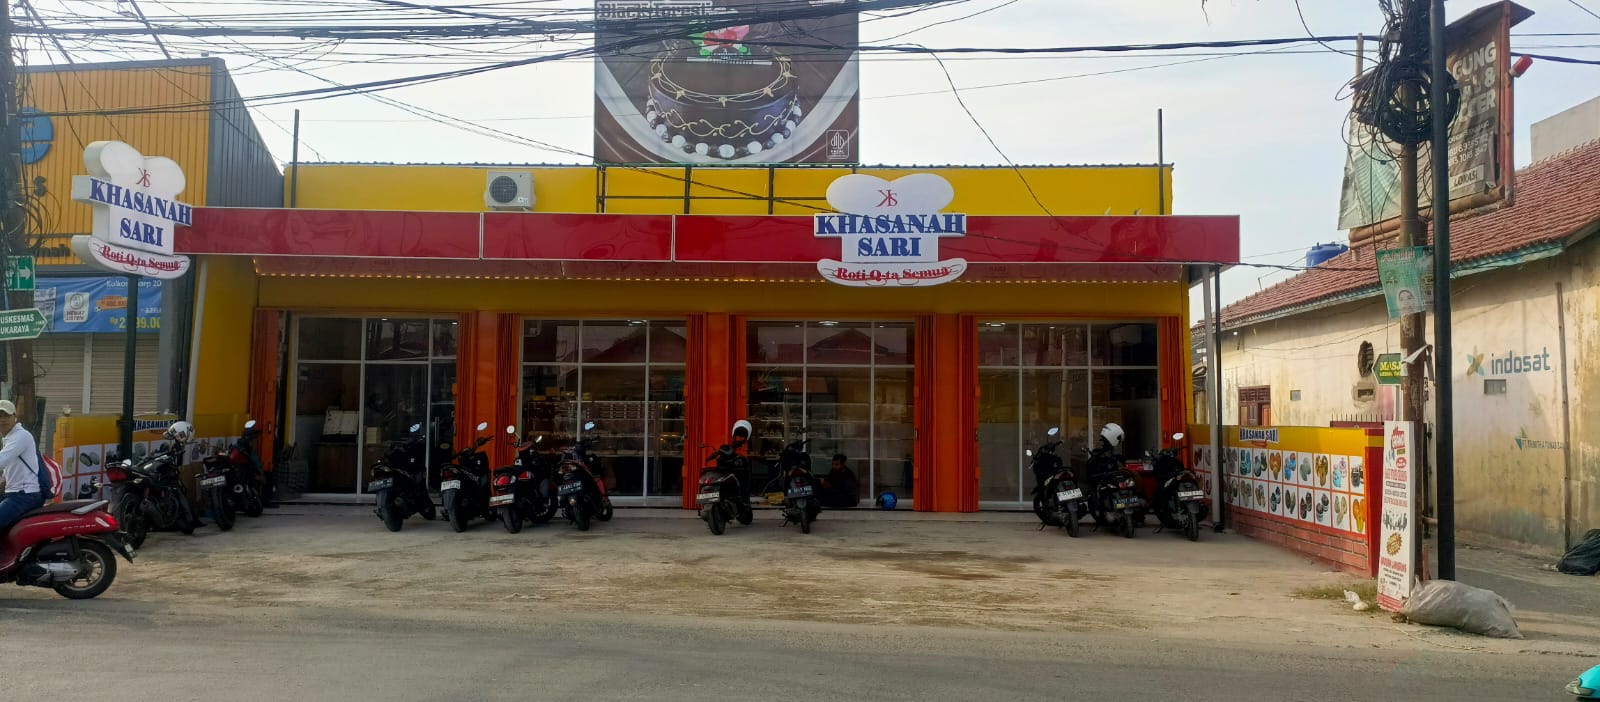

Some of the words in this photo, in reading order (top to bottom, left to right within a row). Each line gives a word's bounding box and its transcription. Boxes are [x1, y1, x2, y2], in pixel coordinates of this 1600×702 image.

[89, 178, 192, 225] KHASANAH
[120, 218, 164, 247] SARI
[816, 214, 965, 234] KHASANAH
[101, 245, 124, 260] Roti
[148, 257, 180, 270] Semua
[858, 237, 922, 257] SARI
[836, 267, 866, 280] Roti
[902, 265, 950, 279] Semua
[1491, 346, 1551, 375] indosat
